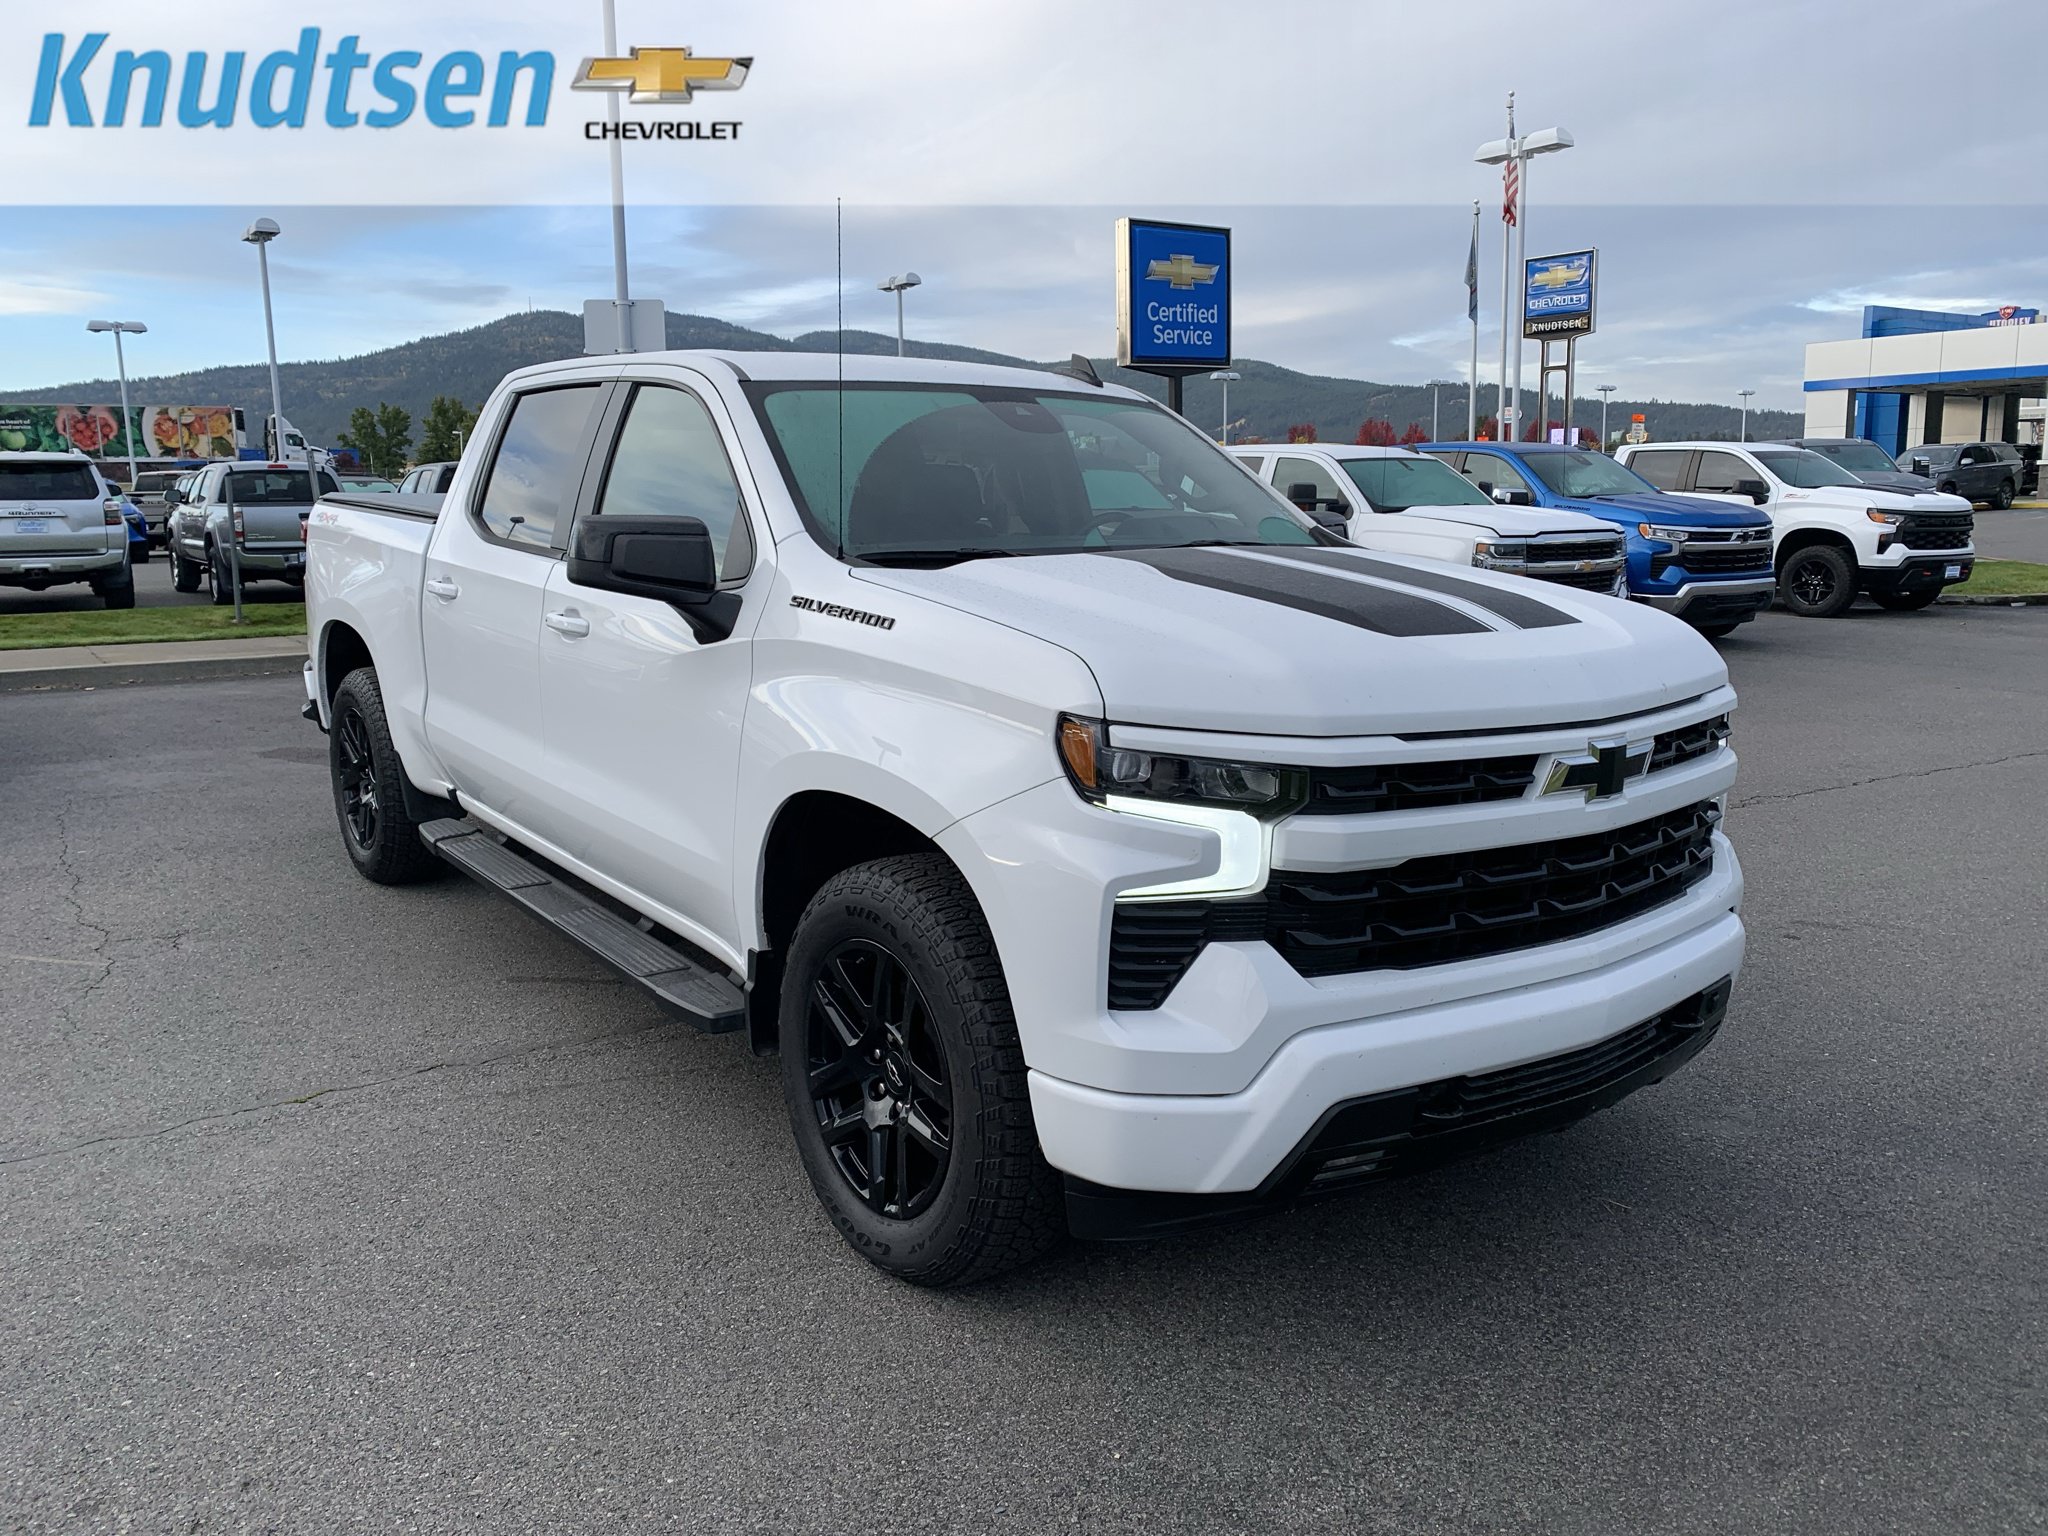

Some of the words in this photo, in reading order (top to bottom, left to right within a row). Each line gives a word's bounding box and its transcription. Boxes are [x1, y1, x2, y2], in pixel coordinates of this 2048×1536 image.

[1147, 301, 1218, 324] Certified
[1529, 294, 1587, 309] CHEVROLET
[1153, 324, 1213, 346] Service
[1532, 319, 1581, 332] KNUDTSEN
[789, 595, 896, 631] SILVERADO
